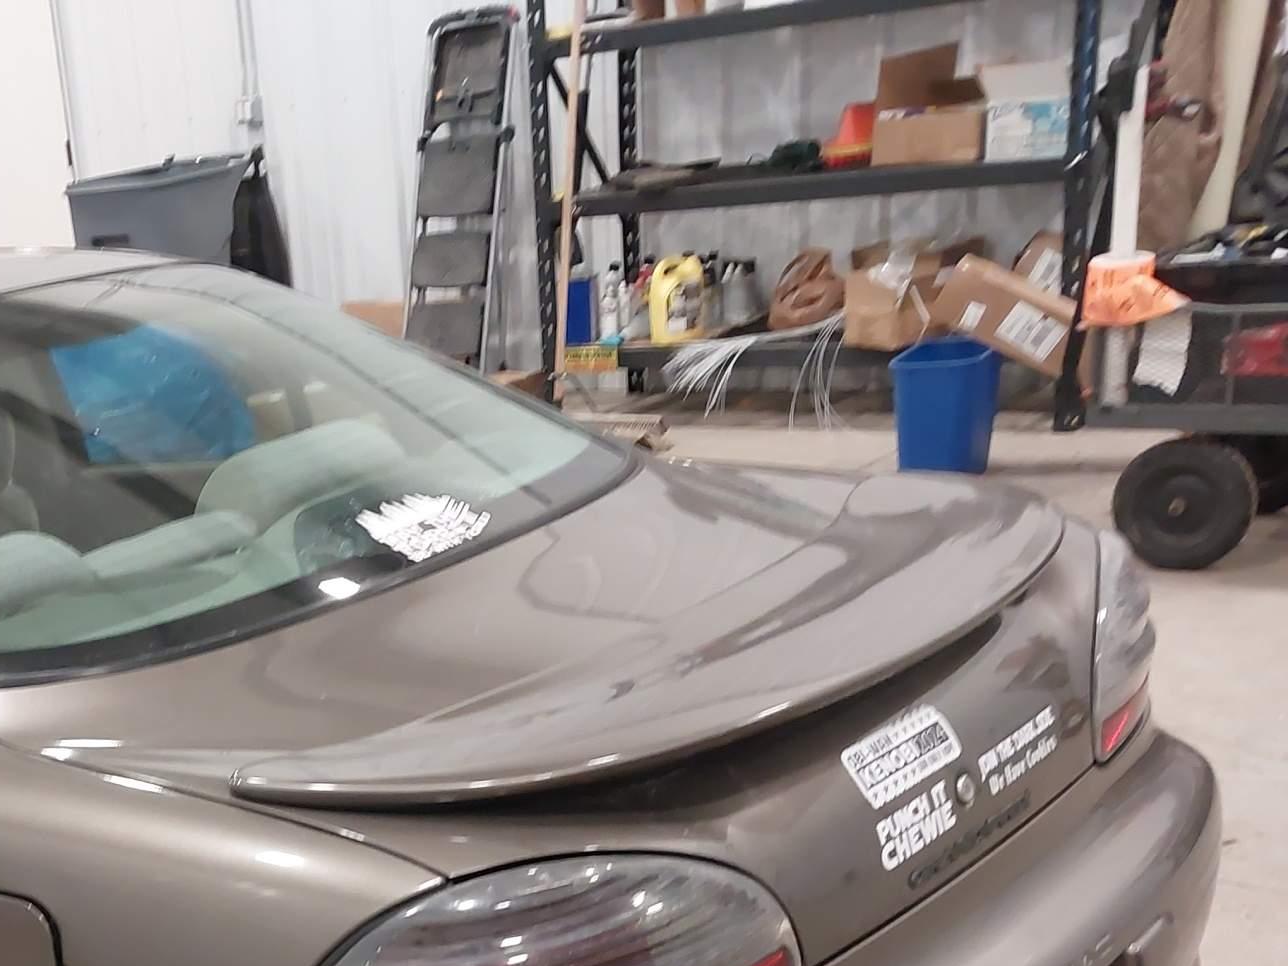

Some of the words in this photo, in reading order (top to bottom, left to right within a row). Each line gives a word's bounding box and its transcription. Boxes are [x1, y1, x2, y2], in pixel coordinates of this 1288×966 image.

[876, 792, 930, 846] PUNCH
[931, 779, 948, 809] IT
[881, 799, 958, 872] CHEWIE
